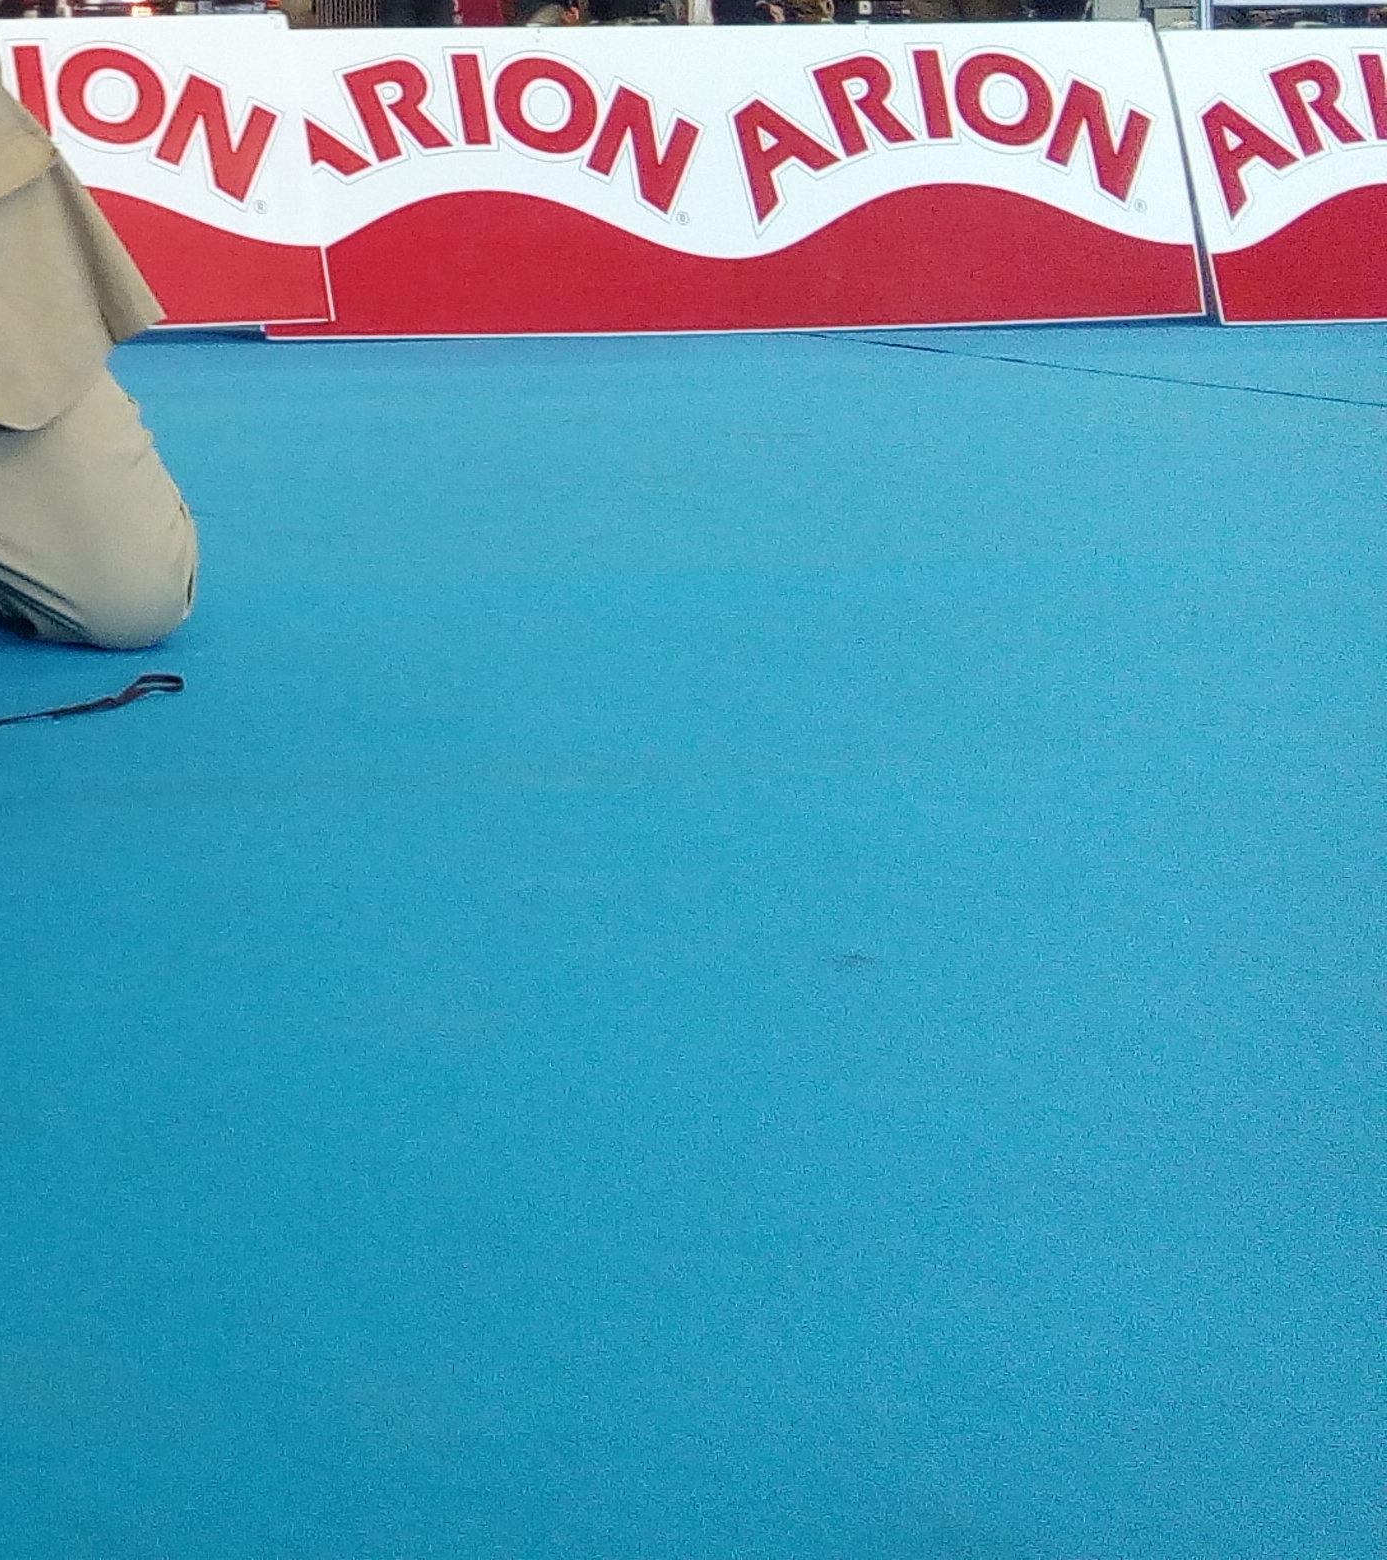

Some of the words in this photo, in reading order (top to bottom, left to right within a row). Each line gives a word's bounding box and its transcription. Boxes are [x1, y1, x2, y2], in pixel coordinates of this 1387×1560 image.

[10, 43, 278, 206] ION
[732, 48, 1153, 227] ARION
[1200, 51, 1387, 223] ARI
